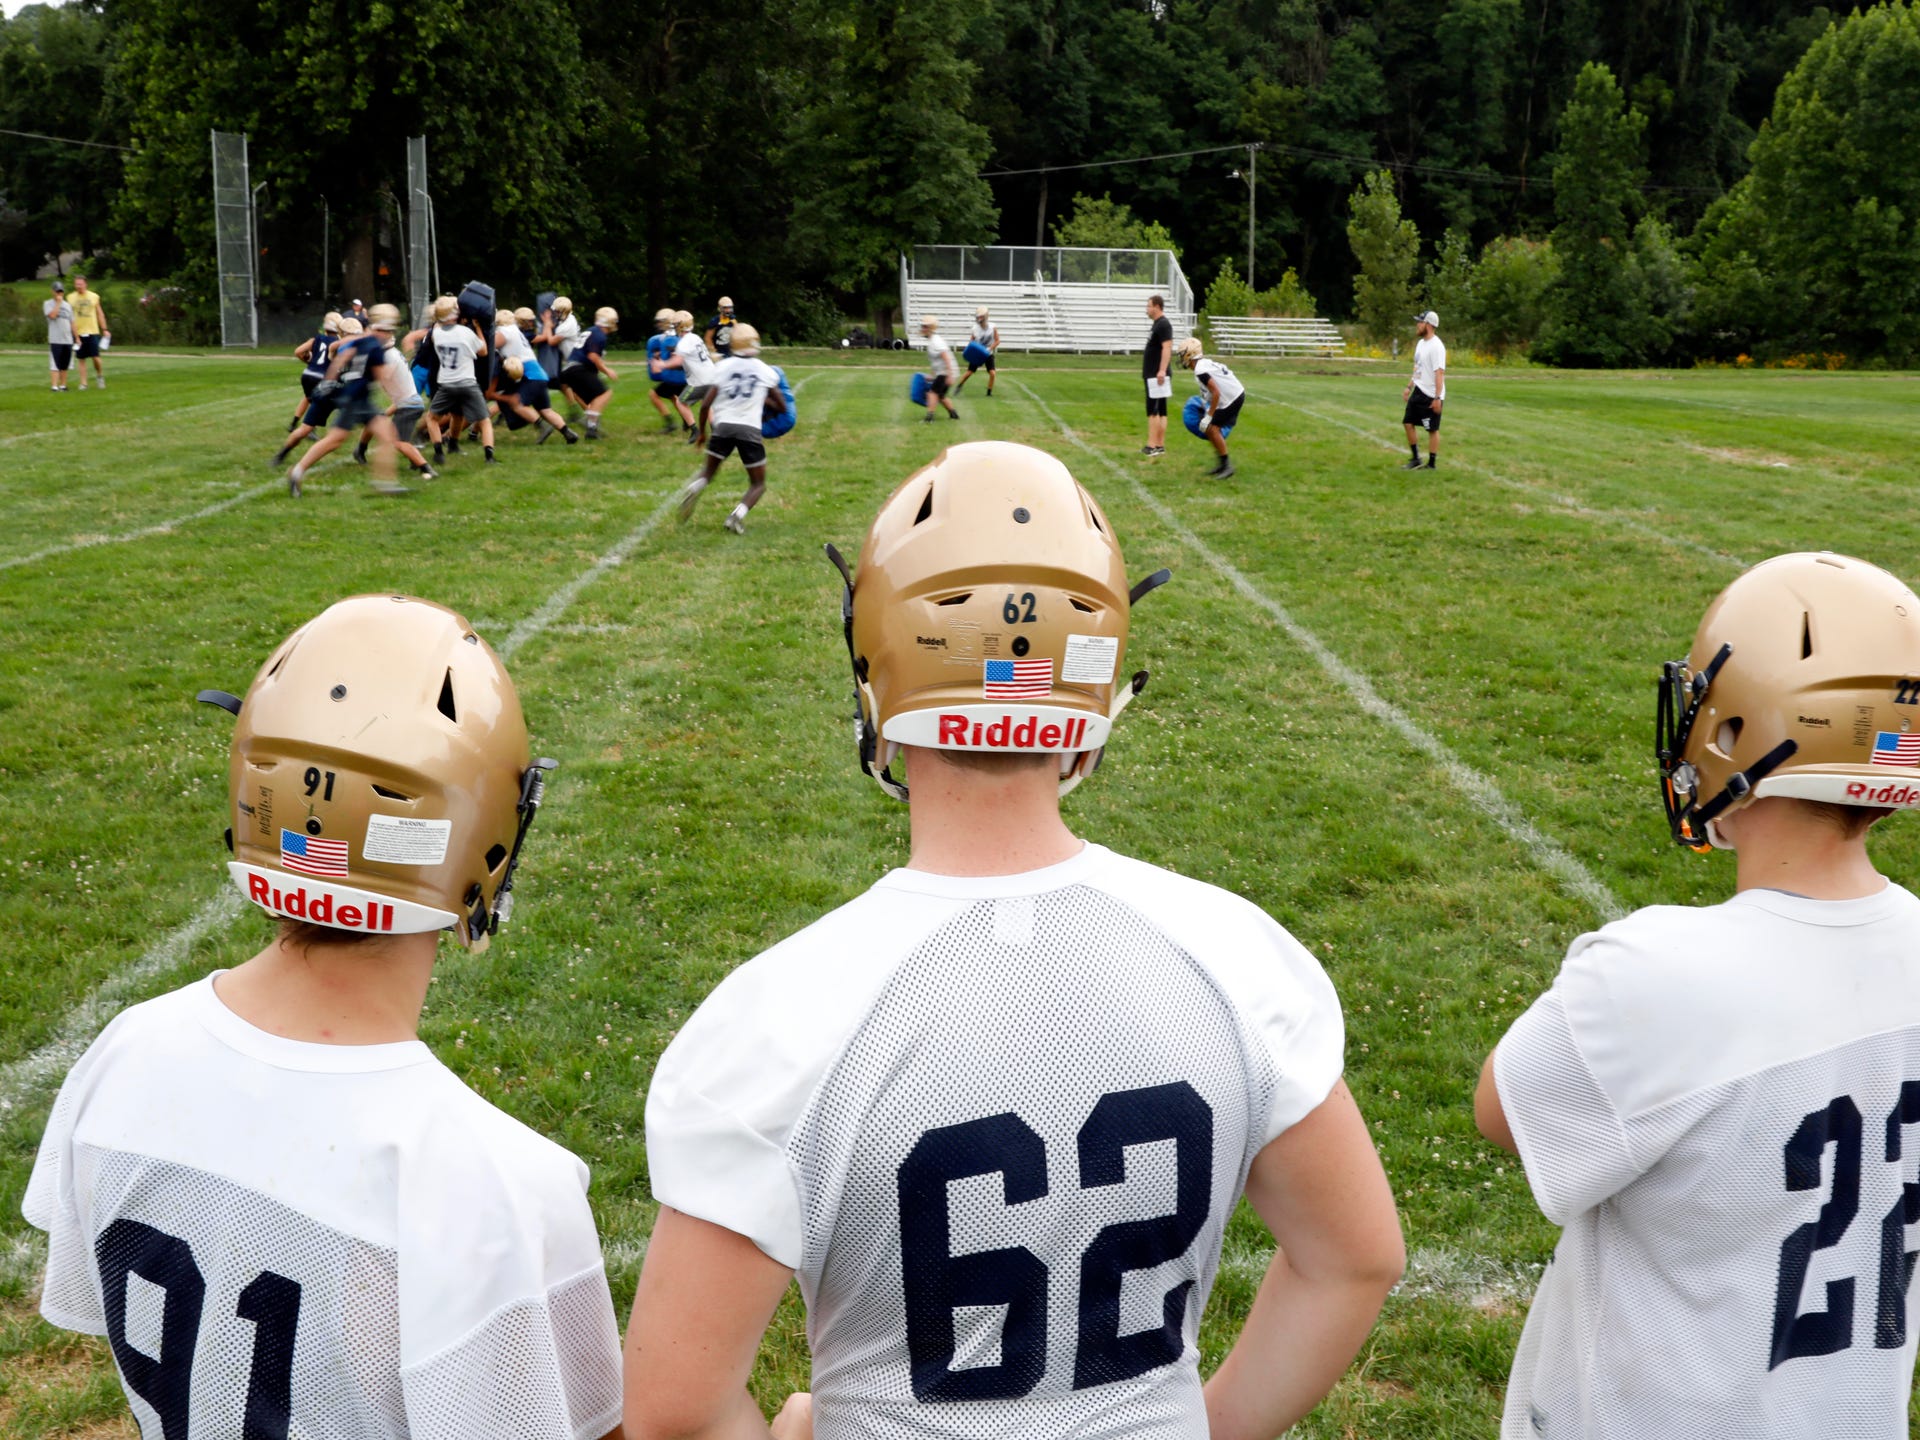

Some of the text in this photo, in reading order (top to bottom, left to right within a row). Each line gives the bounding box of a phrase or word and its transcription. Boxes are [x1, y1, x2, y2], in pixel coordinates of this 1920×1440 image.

[1002, 592, 1037, 624] 62
[916, 635, 946, 646] Riddell
[1894, 679, 1920, 705] 22
[938, 714, 1087, 749] Riddell
[303, 766, 336, 802] 91
[1846, 782, 1920, 804] Ridde
[248, 872, 394, 931] Riddell
[897, 1080, 1214, 1403] 62
[94, 1218, 302, 1440] 91
